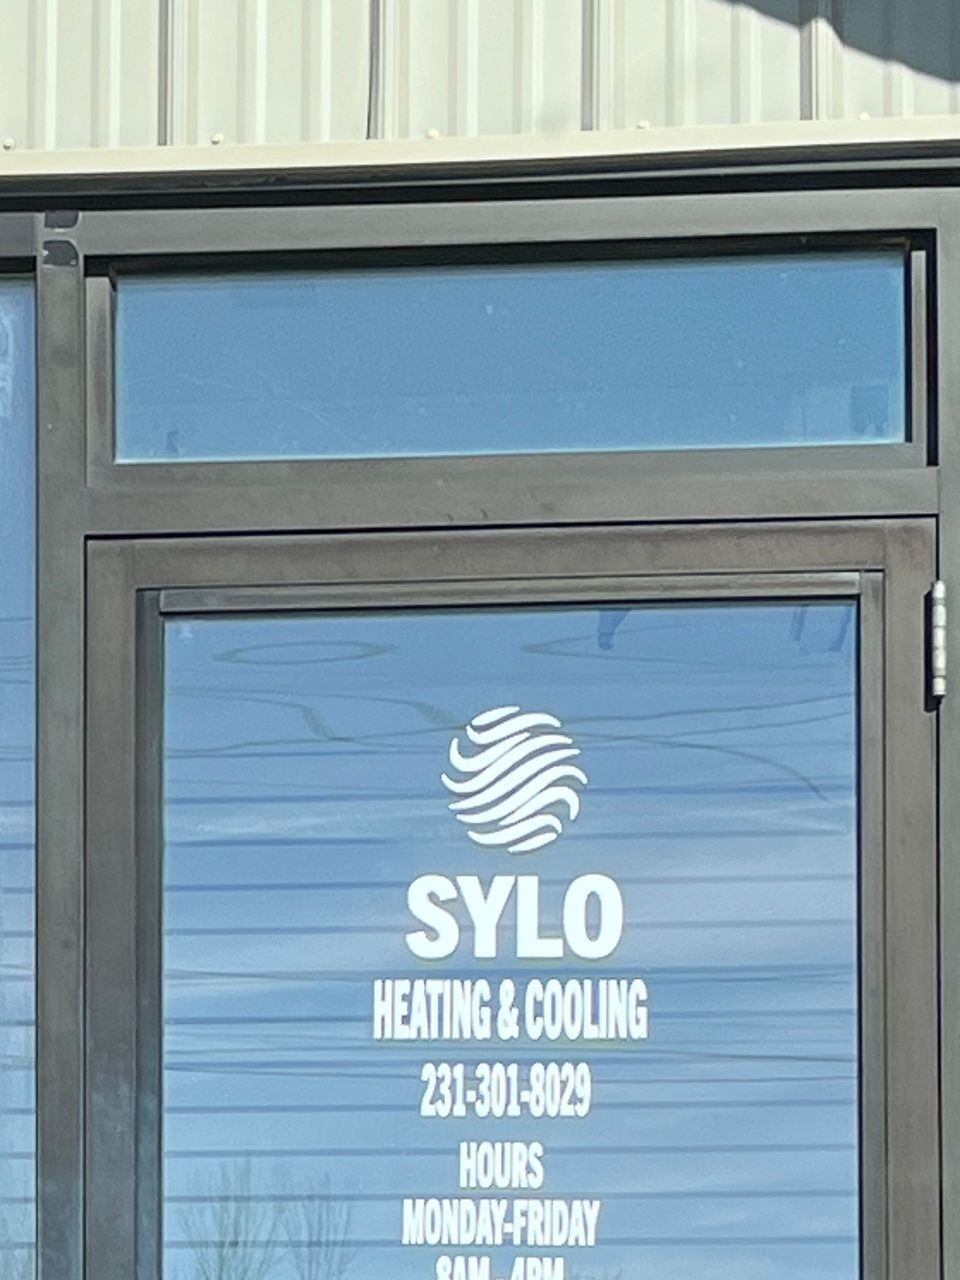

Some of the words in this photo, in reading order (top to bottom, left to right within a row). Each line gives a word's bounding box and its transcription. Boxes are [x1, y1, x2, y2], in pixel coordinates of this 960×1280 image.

[405, 874, 624, 959] SYLO
[373, 979, 492, 1040] HEATING
[497, 979, 520, 1040] &
[525, 978, 648, 1040] COOLING
[420, 1062, 592, 1117] 231-301-8029
[459, 1141, 544, 1189] HOURS
[402, 1198, 601, 1247] MONDAY-FRIDAY
